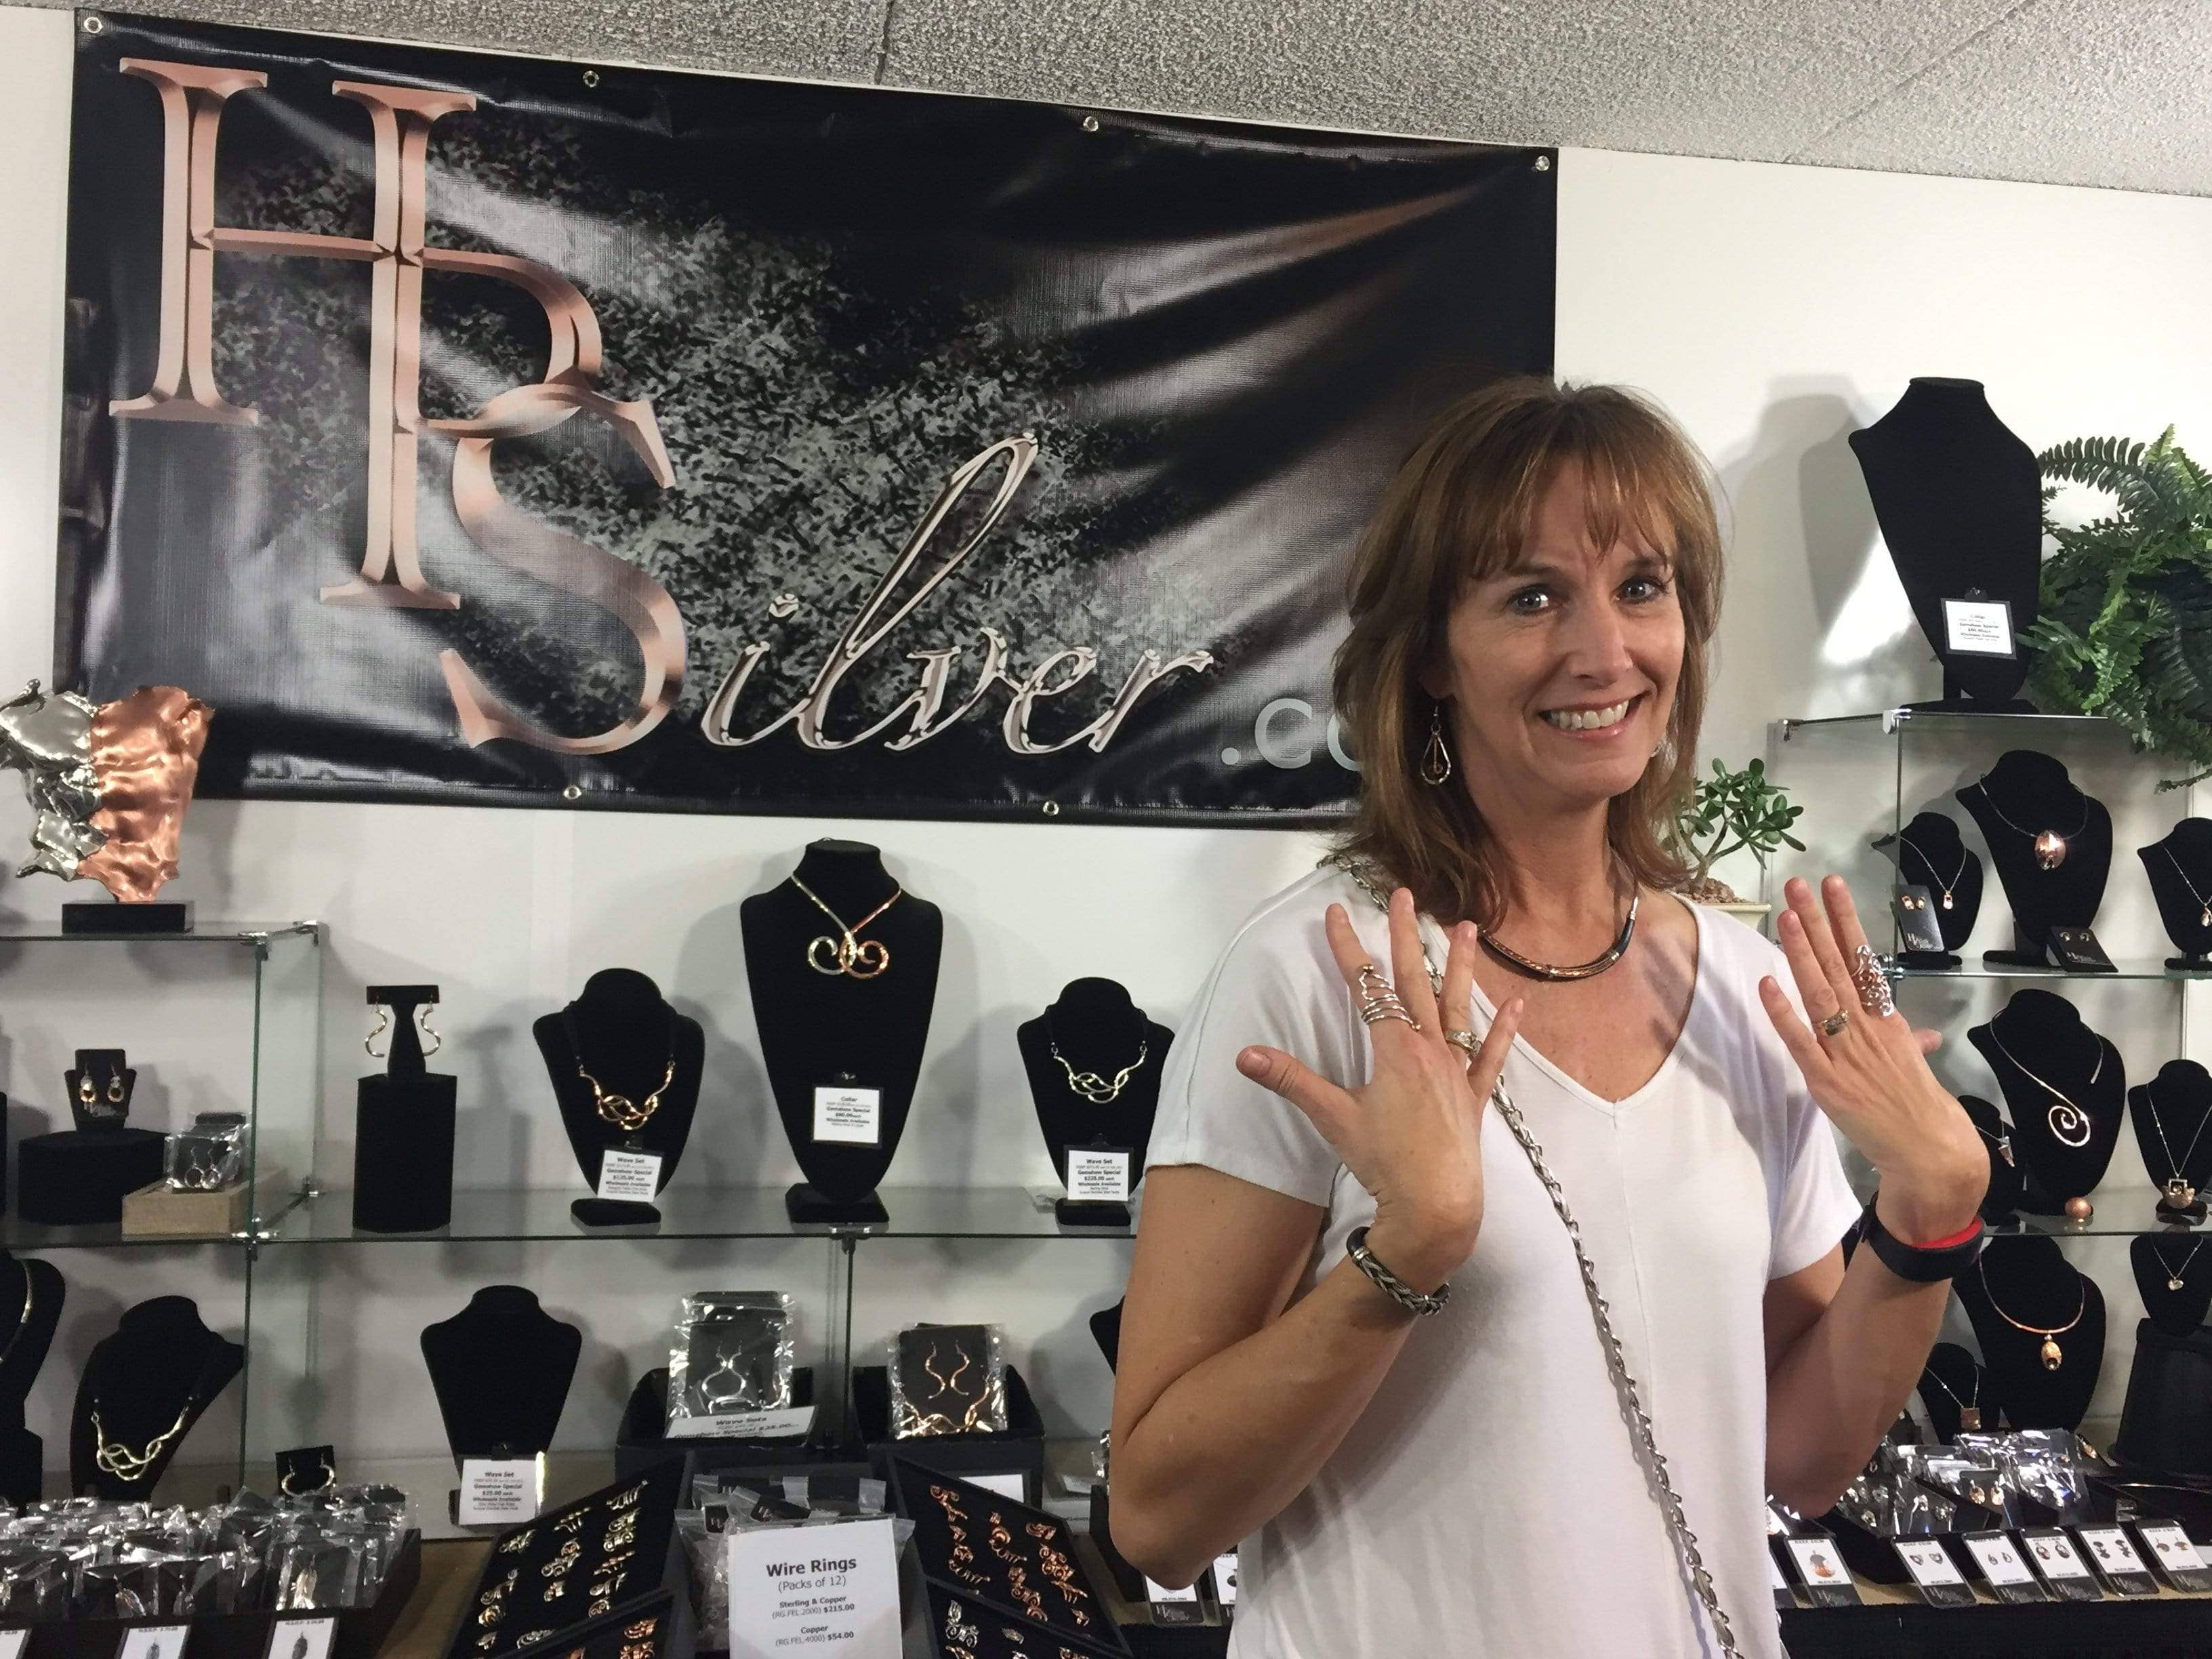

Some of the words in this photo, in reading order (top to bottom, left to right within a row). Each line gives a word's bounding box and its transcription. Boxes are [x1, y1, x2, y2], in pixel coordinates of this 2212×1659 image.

[766, 1563, 806, 1577] Wire
[811, 1558, 857, 1573] Rings
[778, 1580, 813, 1593] (Packs
[815, 1577, 825, 1587] of
[830, 1575, 846, 1587] 12)
[779, 1600, 810, 1608] Sterling
[823, 1603, 855, 1613] $215.00
[827, 1631, 854, 1641] $54.00
